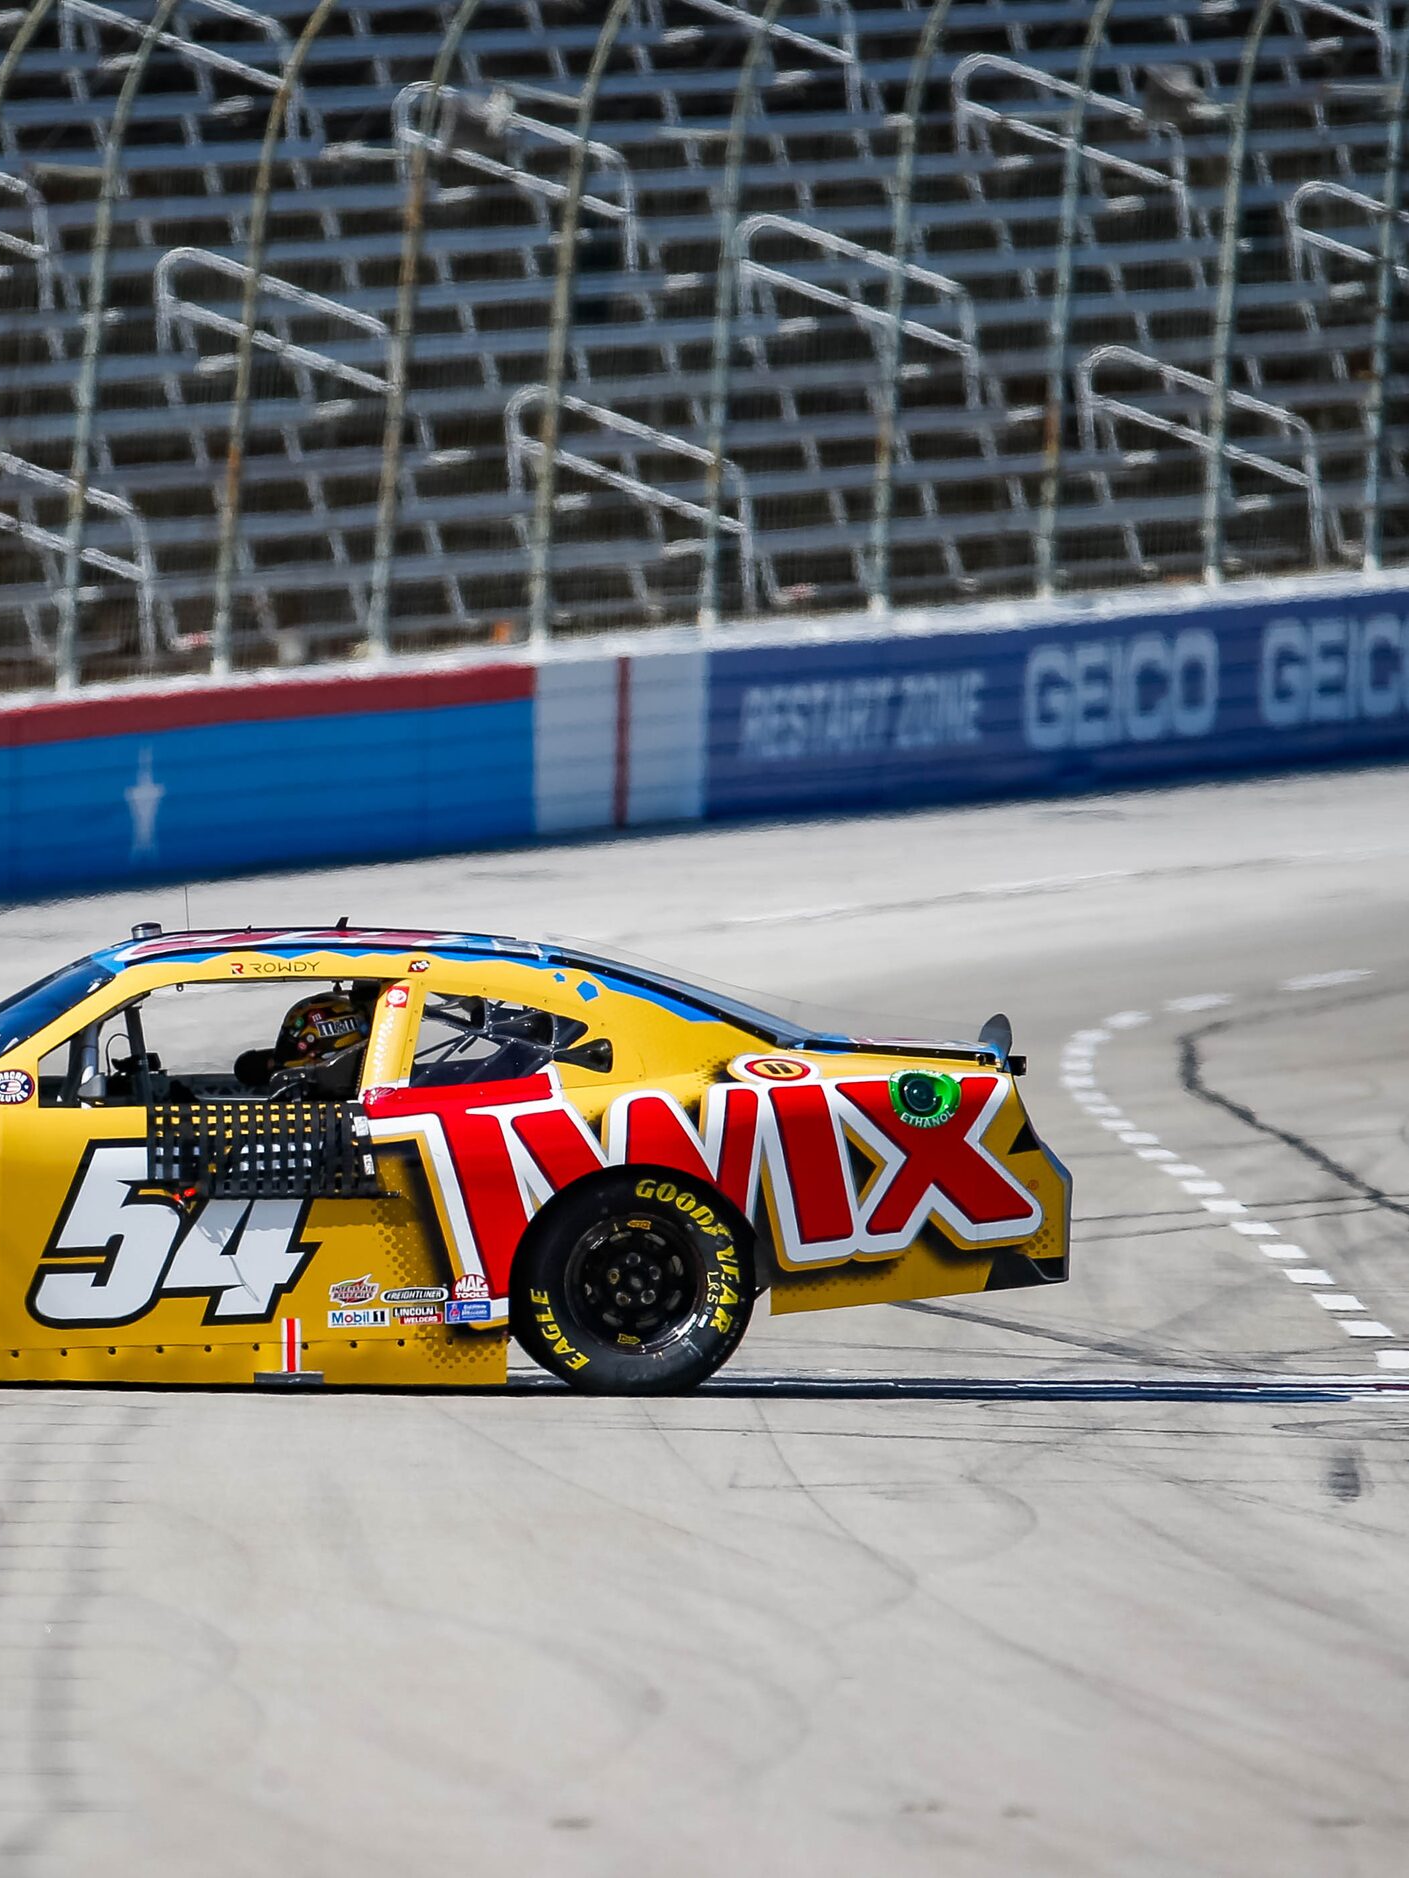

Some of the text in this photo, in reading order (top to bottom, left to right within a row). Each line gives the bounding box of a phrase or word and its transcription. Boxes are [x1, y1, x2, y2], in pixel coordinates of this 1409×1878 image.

[1259, 612, 1409, 730] GEIC
[1023, 628, 1220, 751] GEICO
[738, 667, 986, 762] RESTART ZONE
[249, 961, 321, 973] ROWDY
[899, 1110, 956, 1128] ETHANOL
[26, 1139, 322, 1329] 54
[635, 1179, 741, 1334] GOODYEAR
[331, 1285, 378, 1293] INTERSTATE
[454, 1275, 489, 1292] MAC
[332, 1292, 374, 1300] BATTERIES
[385, 1289, 442, 1300] FREIGHTLINER
[331, 1310, 370, 1323] Mobil
[394, 1307, 434, 1316] LINCOLN
[403, 1315, 439, 1324] WELDERS
[530, 1288, 591, 1371] EAGLE
